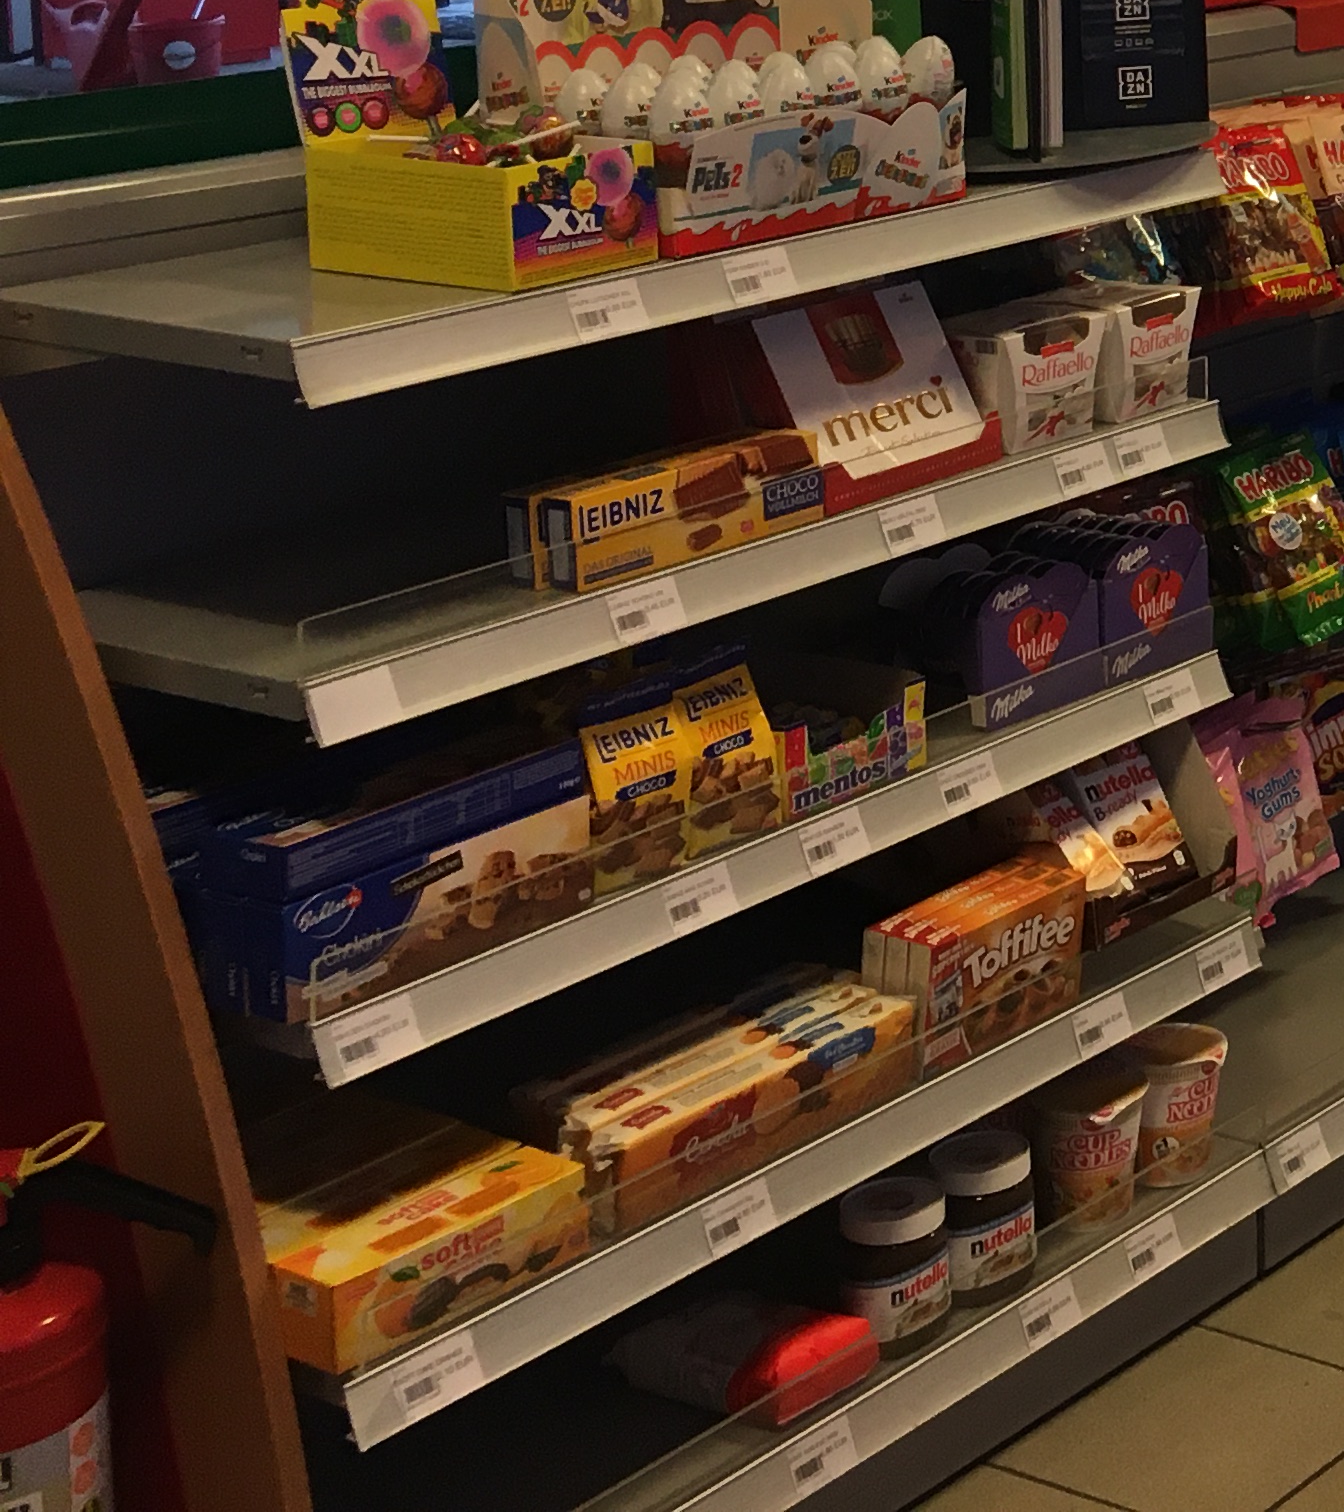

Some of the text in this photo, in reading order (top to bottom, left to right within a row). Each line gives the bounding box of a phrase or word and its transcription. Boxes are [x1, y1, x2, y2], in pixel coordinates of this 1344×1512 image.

[292, 31, 390, 81] XXL
[732, 163, 743, 189] 2
[537, 203, 602, 240] XXL
[1130, 326, 1189, 358] Raffaello
[1021, 352, 1094, 387] Raffaello
[822, 384, 954, 448] merci
[766, 474, 820, 503] CHOCO
[1235, 453, 1315, 503] HARIBO
[579, 489, 664, 534] LEIBNIZ
[767, 490, 820, 516] VOLLMILCH
[1118, 546, 1149, 574] Milka
[993, 583, 1029, 612] Milka
[1139, 592, 1176, 624] Milka
[1017, 633, 1059, 664] Milka
[1113, 643, 1151, 677] Milka
[685, 677, 748, 721] LEIBNIZ
[991, 685, 1034, 721] Milka
[596, 716, 674, 764] LEIBNIZ
[699, 710, 749, 743] MINIS
[714, 736, 744, 756] CHOCO
[614, 750, 676, 786] MINIS
[792, 759, 886, 812] mentos
[1085, 765, 1156, 802] nutella
[627, 776, 667, 798] CHOCO
[1261, 786, 1300, 821] Gums
[1095, 790, 1138, 821] B-ready
[964, 913, 1075, 988] Toffifee
[1054, 1140, 1132, 1172] NOODLES
[1067, 1129, 1120, 1152] CUP
[422, 1233, 471, 1270] soft
[970, 1216, 1032, 1259] nutella
[891, 1261, 947, 1307] nutella
